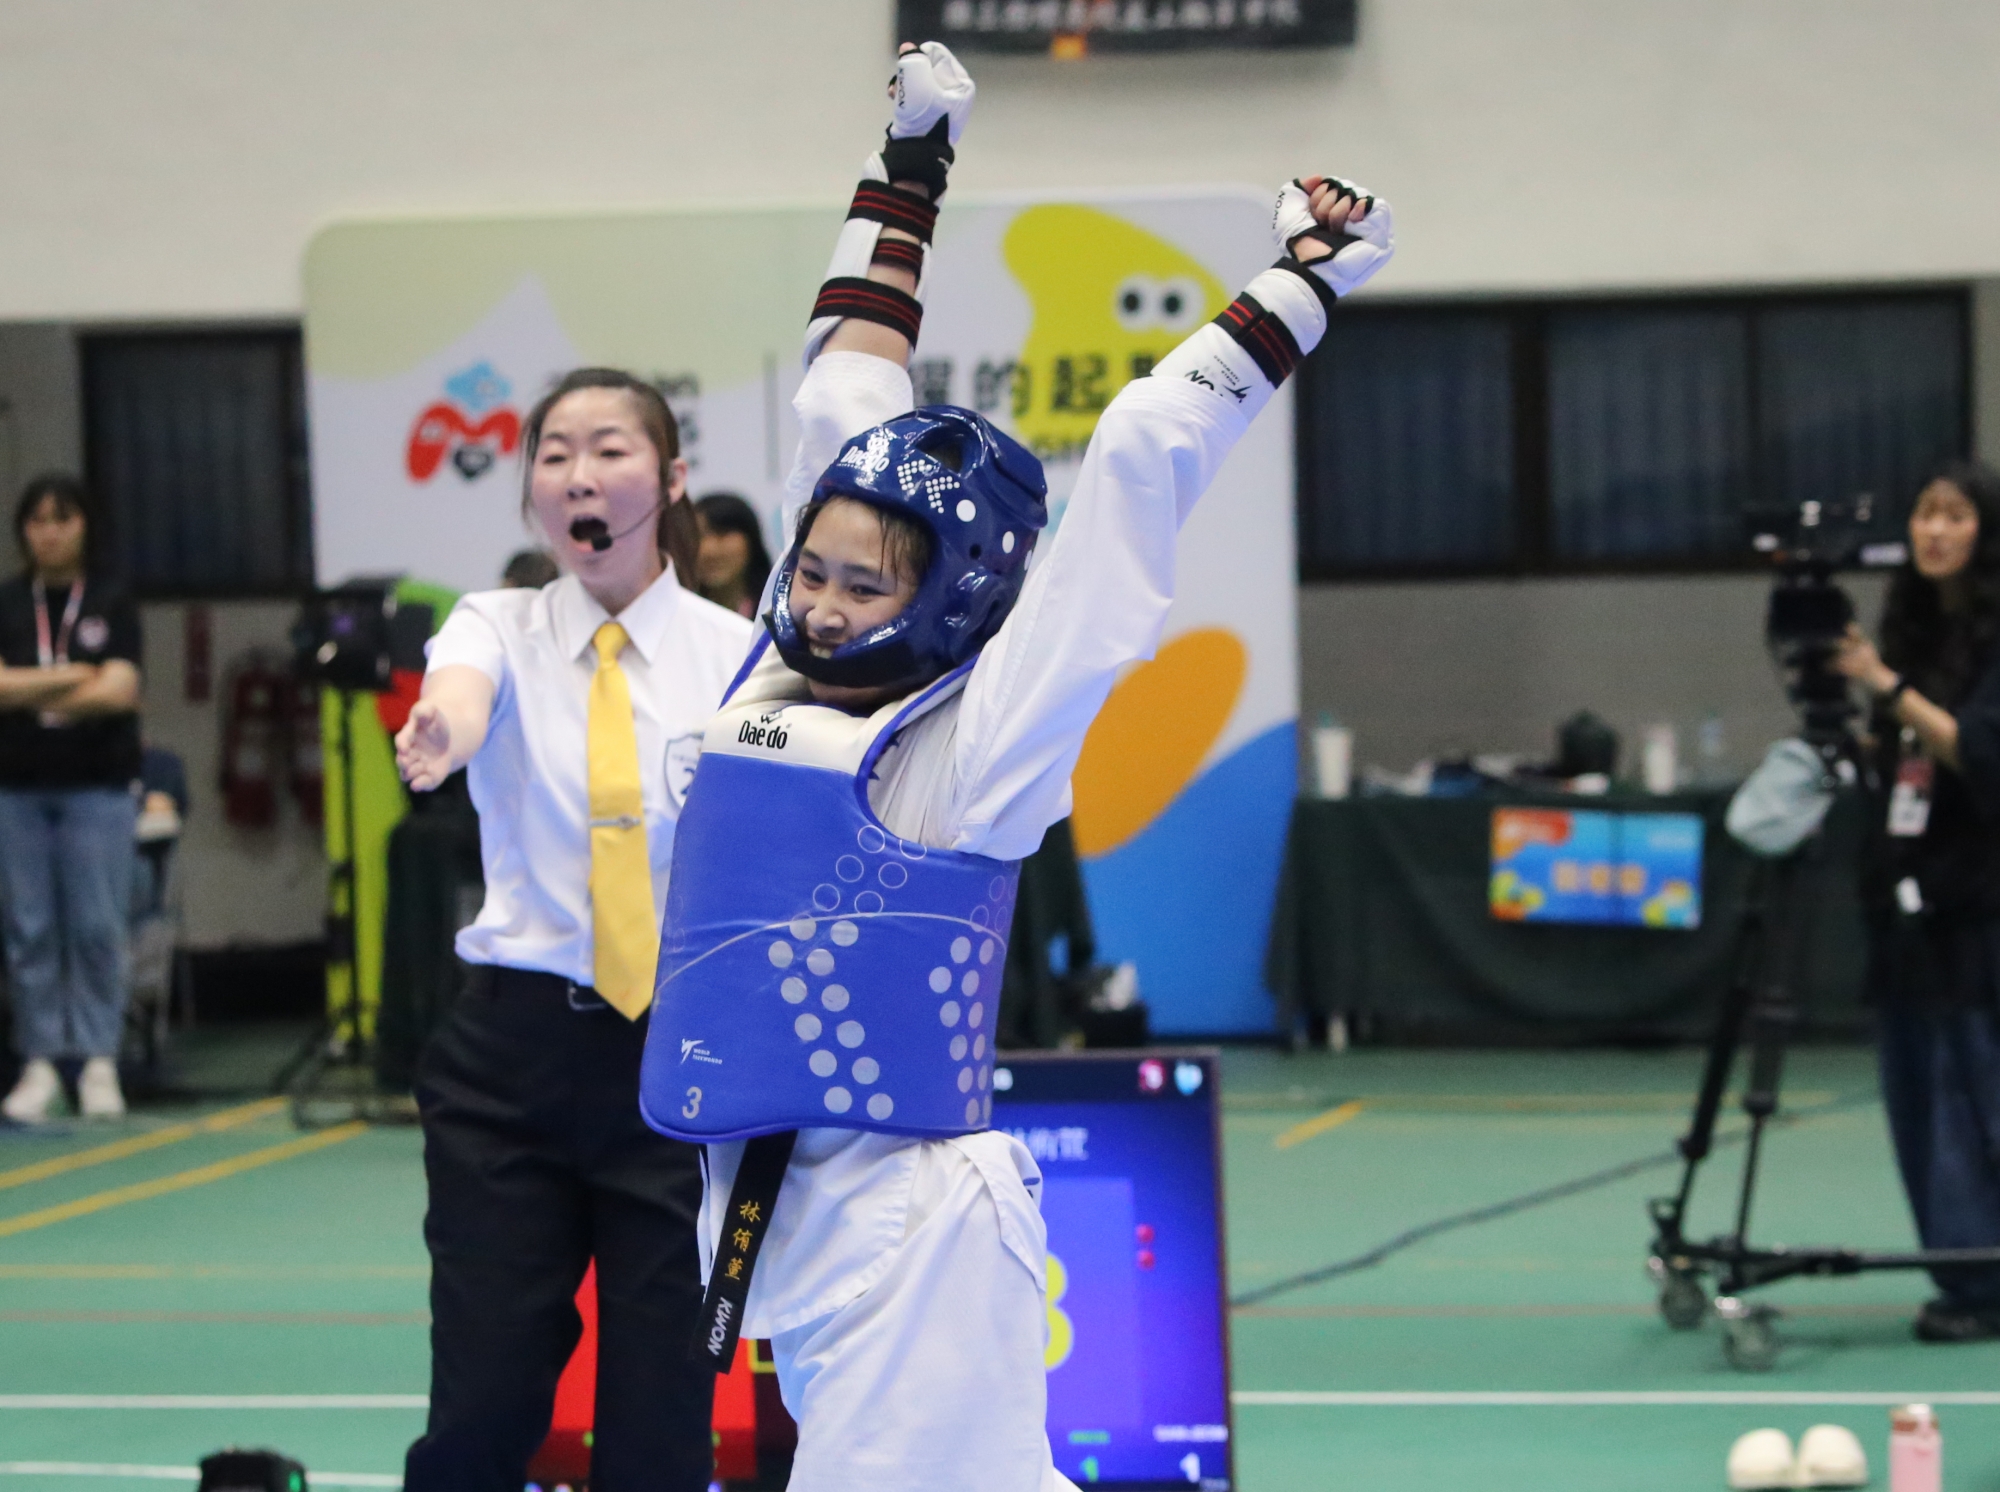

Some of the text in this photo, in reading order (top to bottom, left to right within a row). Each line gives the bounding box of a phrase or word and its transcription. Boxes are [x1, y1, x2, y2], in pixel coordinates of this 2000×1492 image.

[1272, 190, 1286, 230] KWON
[682, 1086, 702, 1119] 3
[707, 1296, 733, 1356] KWON
